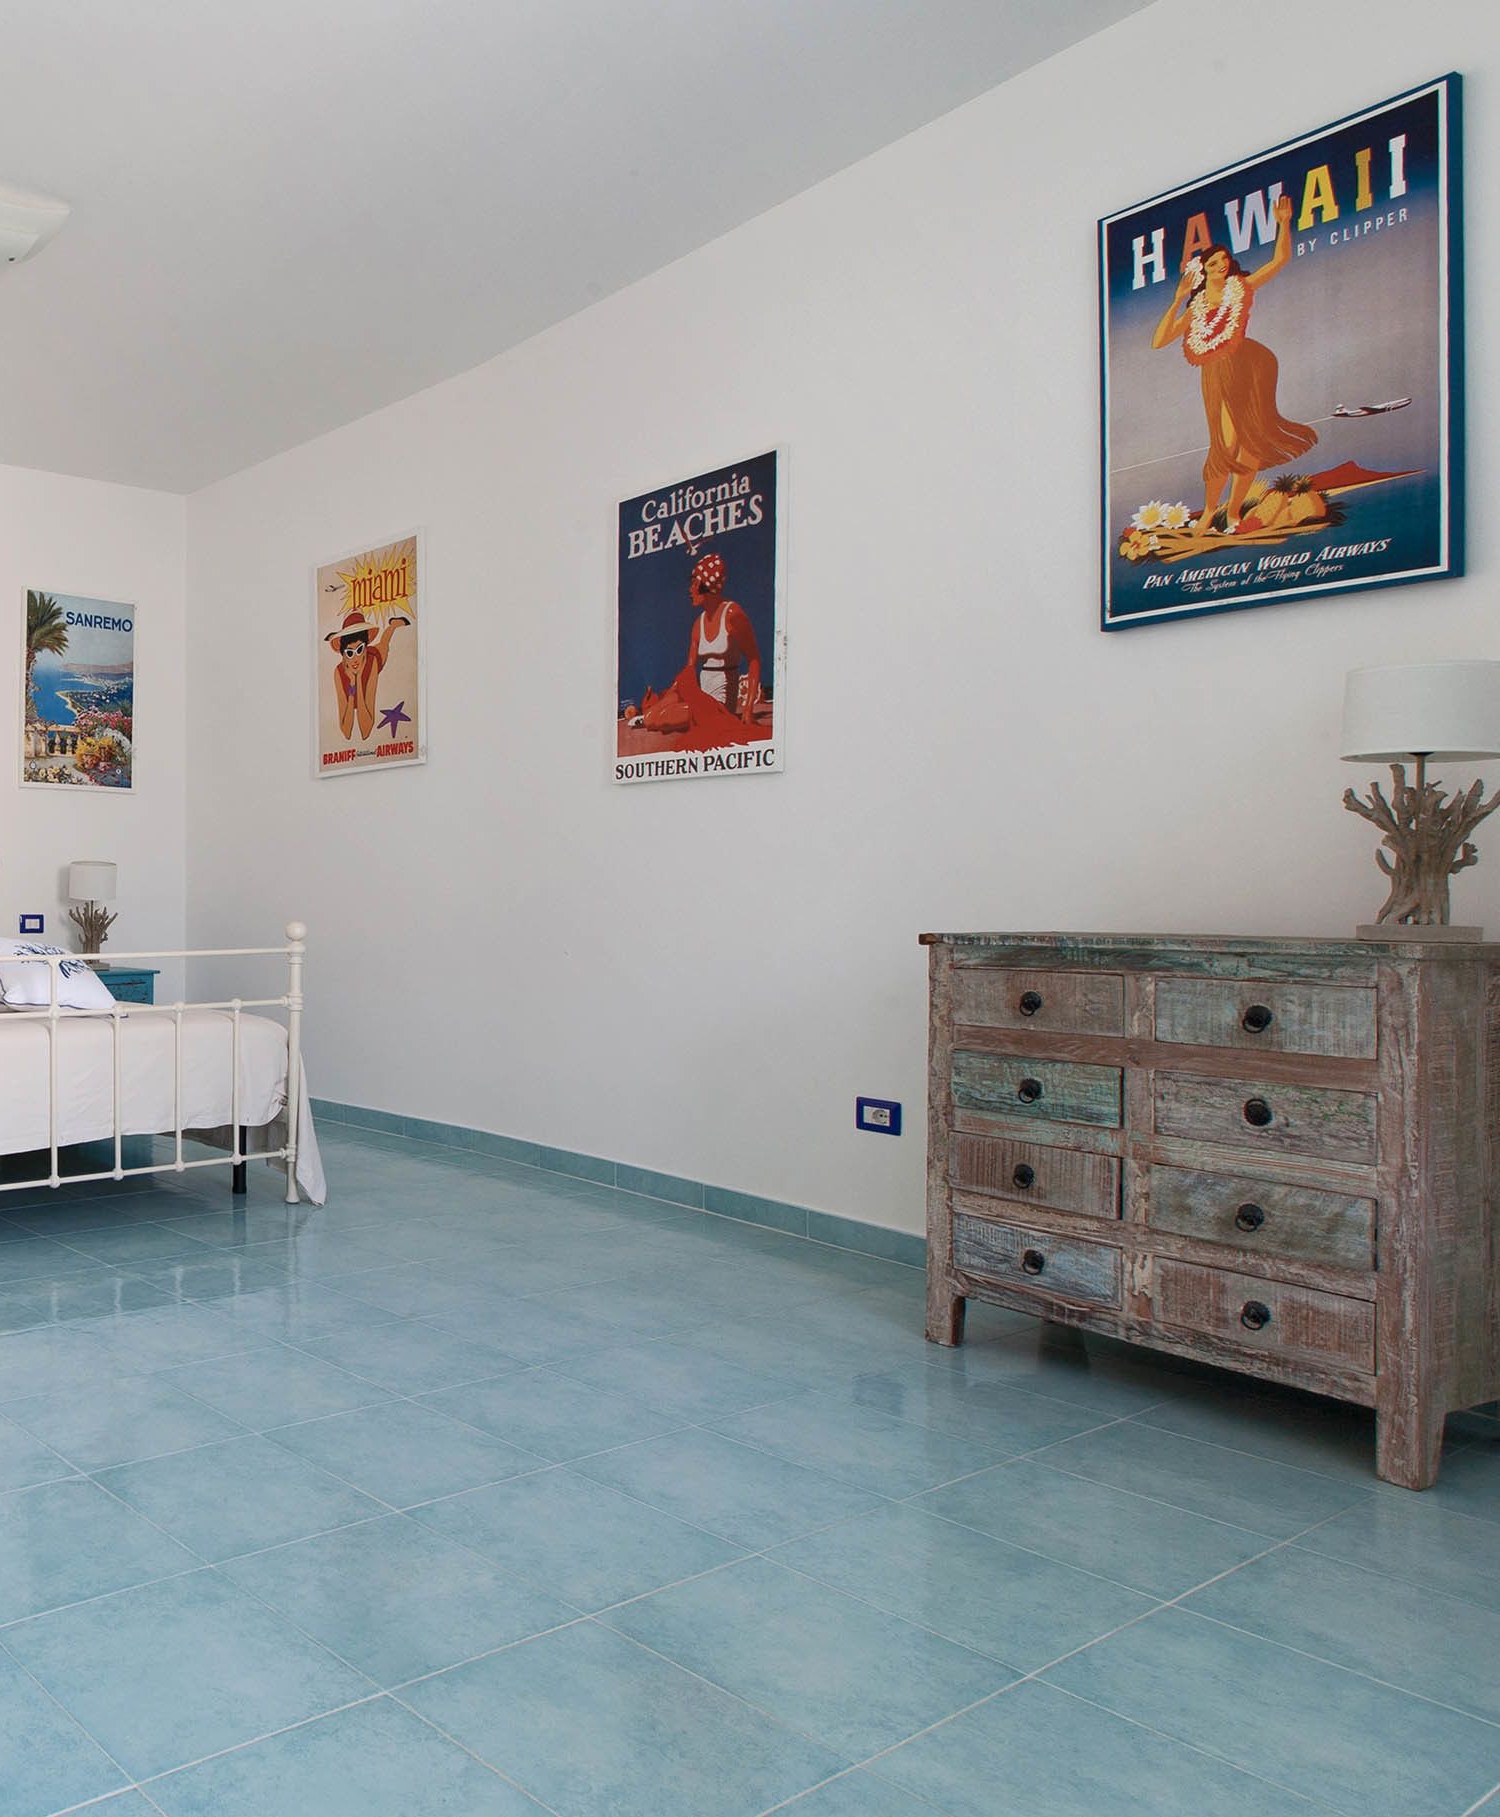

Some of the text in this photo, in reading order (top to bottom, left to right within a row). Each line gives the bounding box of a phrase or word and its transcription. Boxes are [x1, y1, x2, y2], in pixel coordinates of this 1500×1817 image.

[1132, 134, 1408, 290] HAWAII
[1297, 207, 1408, 257] BY CLIPPER
[641, 473, 751, 523] California
[627, 494, 764, 559] BEACHES
[351, 558, 409, 612] miami
[1143, 538, 1393, 590] PAN AMERICAN WORLD AIRWAYS
[1181, 582, 1203, 593] The
[1206, 578, 1237, 593] System
[1241, 573, 1253, 586] of
[1253, 571, 1268, 584] the
[1304, 562, 1345, 578] Clippers
[66, 611, 133, 633] SANREMO
[323, 748, 356, 765] BRANIFF
[376, 741, 414, 758] AIRWAYS
[615, 749, 776, 780] SOUTHERN PACIFIC
